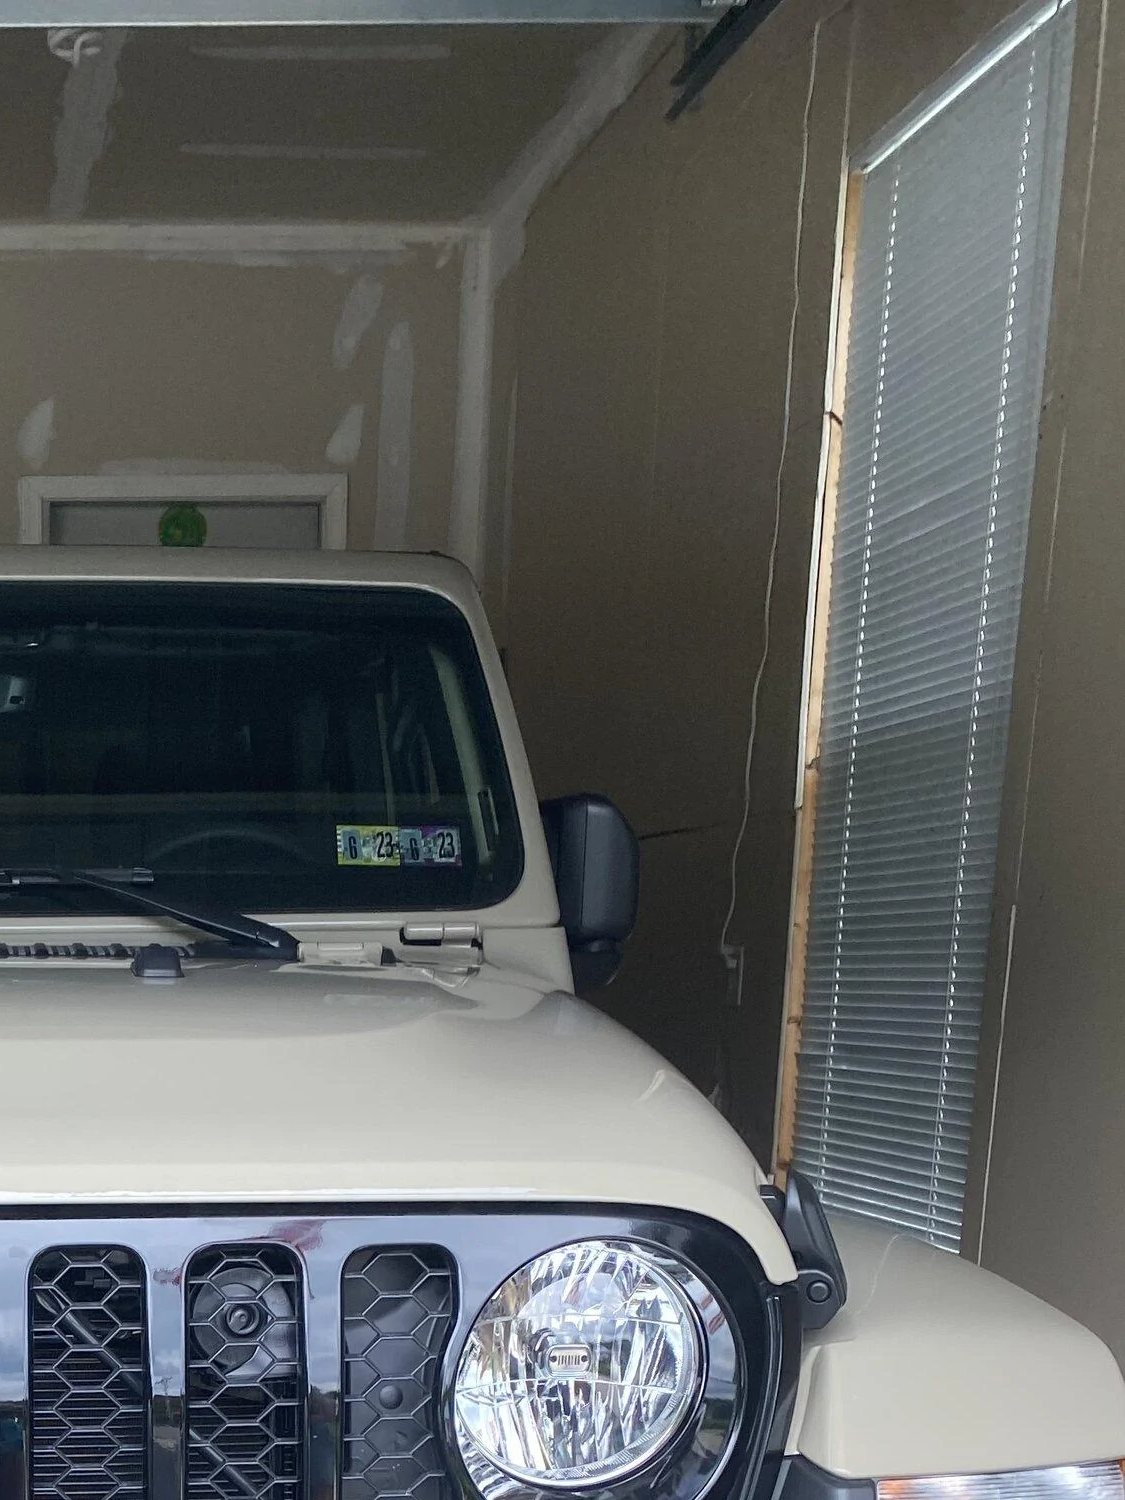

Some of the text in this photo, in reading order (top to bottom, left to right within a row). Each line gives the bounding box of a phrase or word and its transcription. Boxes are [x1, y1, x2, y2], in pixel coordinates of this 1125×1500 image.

[348, 831, 394, 860] 6 23
[437, 832, 455, 859] 23
